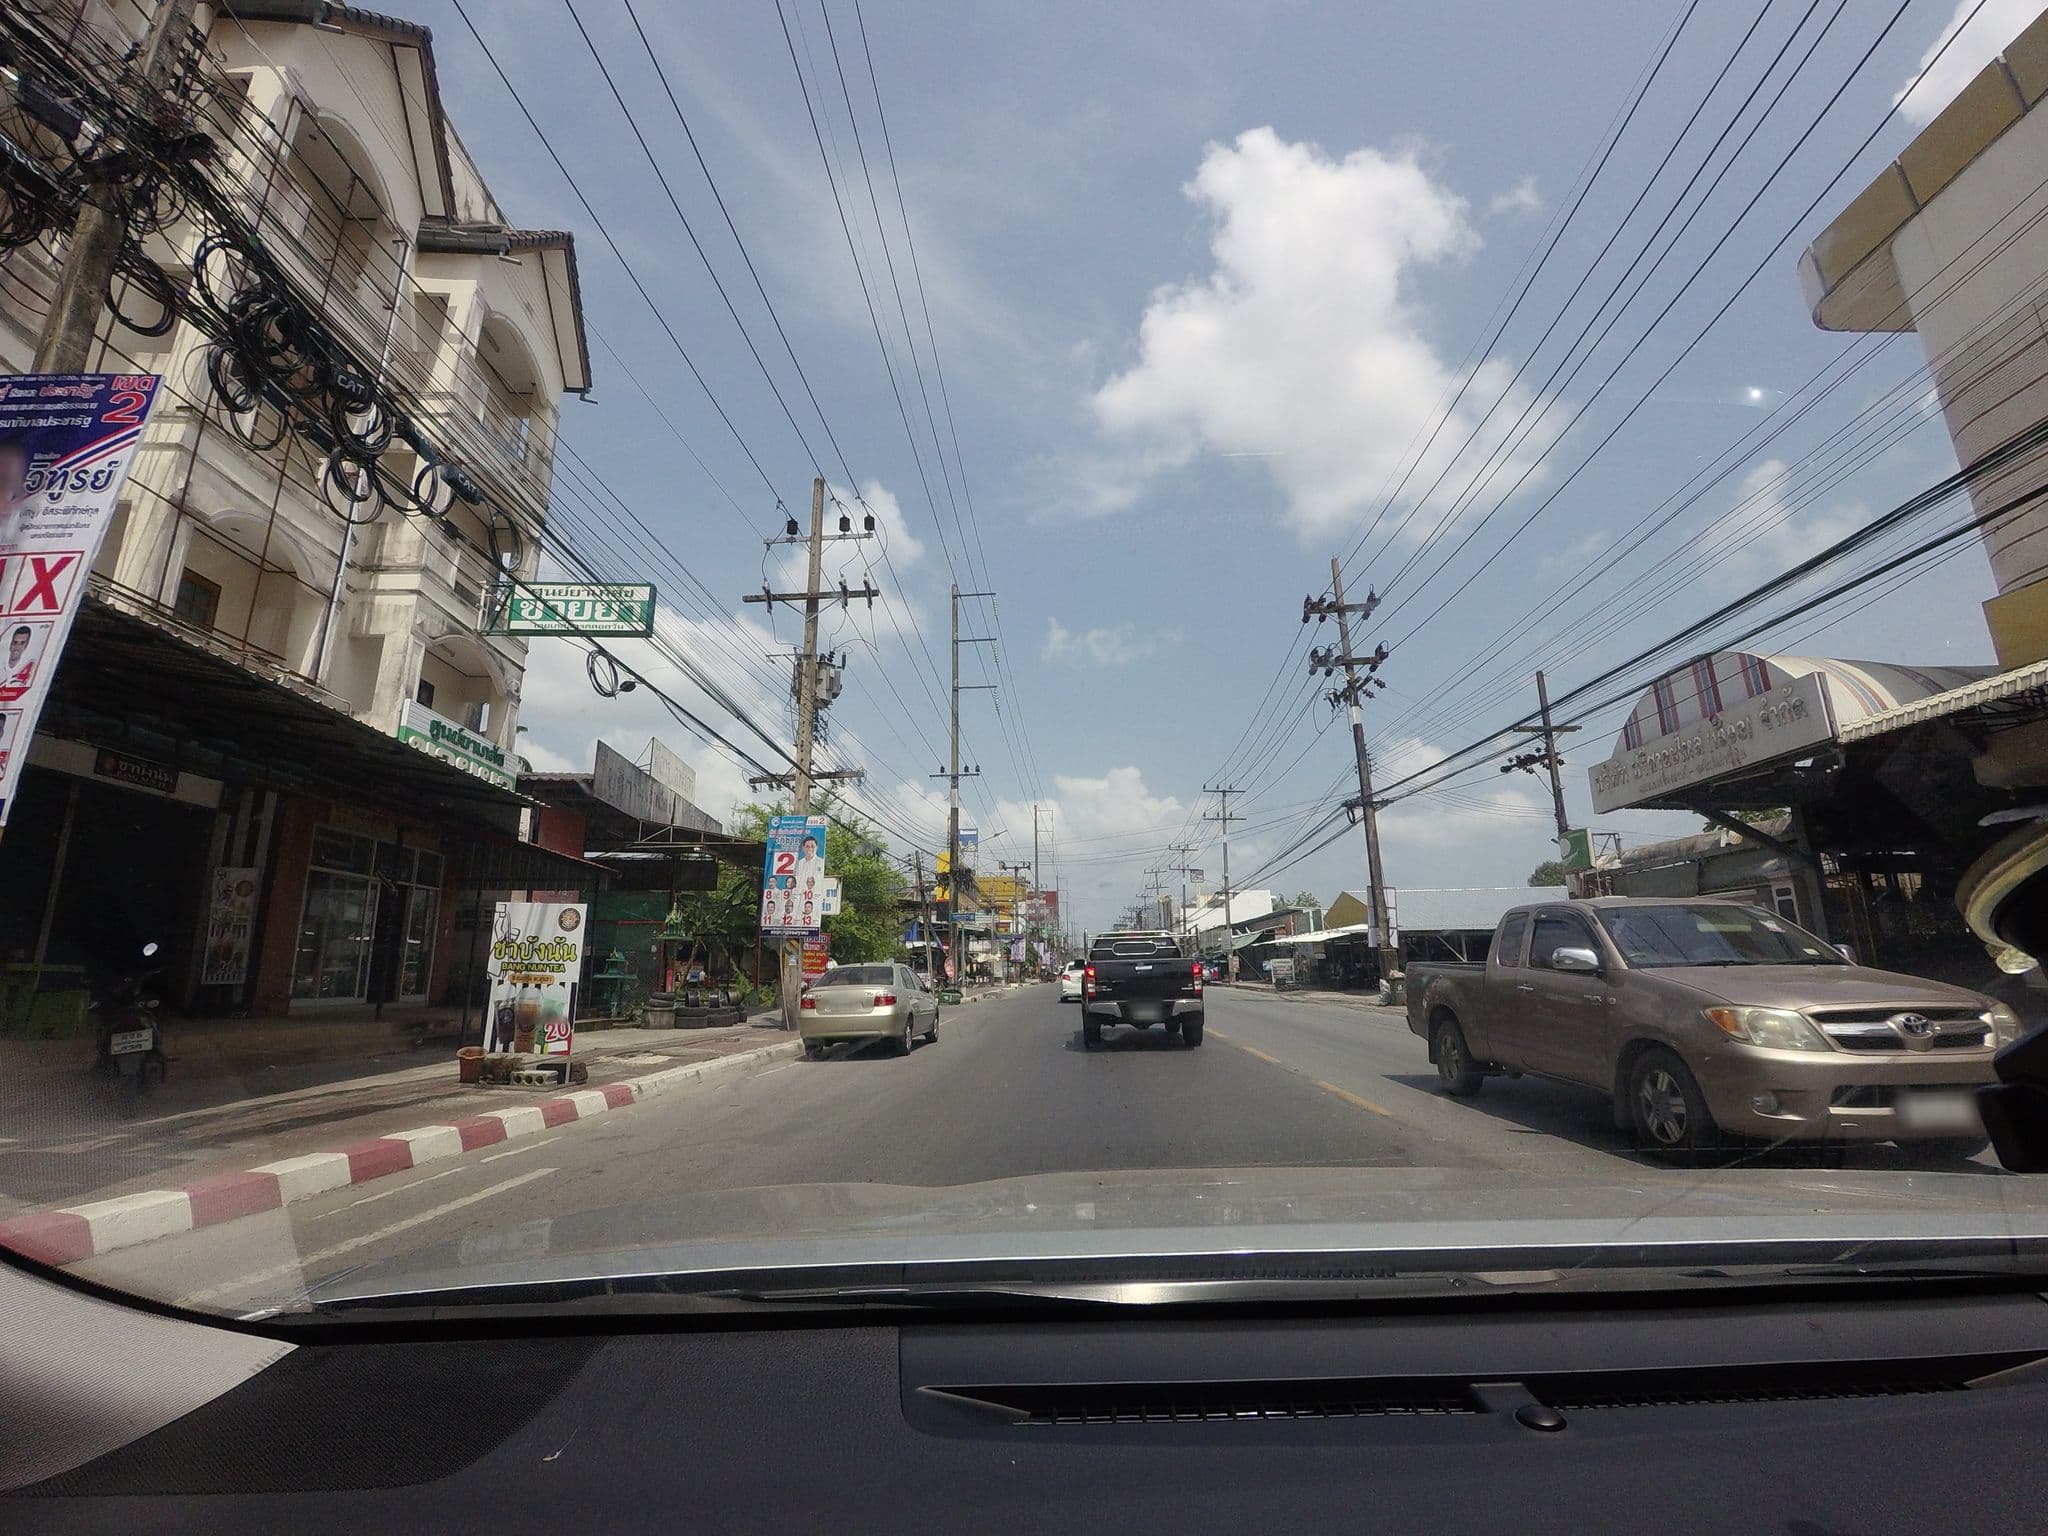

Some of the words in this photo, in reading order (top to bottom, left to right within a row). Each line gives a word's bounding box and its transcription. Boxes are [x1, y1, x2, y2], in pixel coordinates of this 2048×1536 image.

[111, 375, 157, 391] เขต
[337, 374, 366, 396] CAT
[100, 391, 147, 423] 2
[775, 852, 796, 875] 2
[765, 890, 773, 900] 8
[783, 890, 790, 900] 9
[803, 890, 813, 900] 10
[763, 915, 772, 925] 11
[782, 915, 793, 925] 12
[802, 915, 812, 925] 13
[501, 961, 526, 971] BANG
[527, 963, 547, 972] NUN
[548, 963, 566, 973] TEA
[545, 1023, 570, 1042] 20
